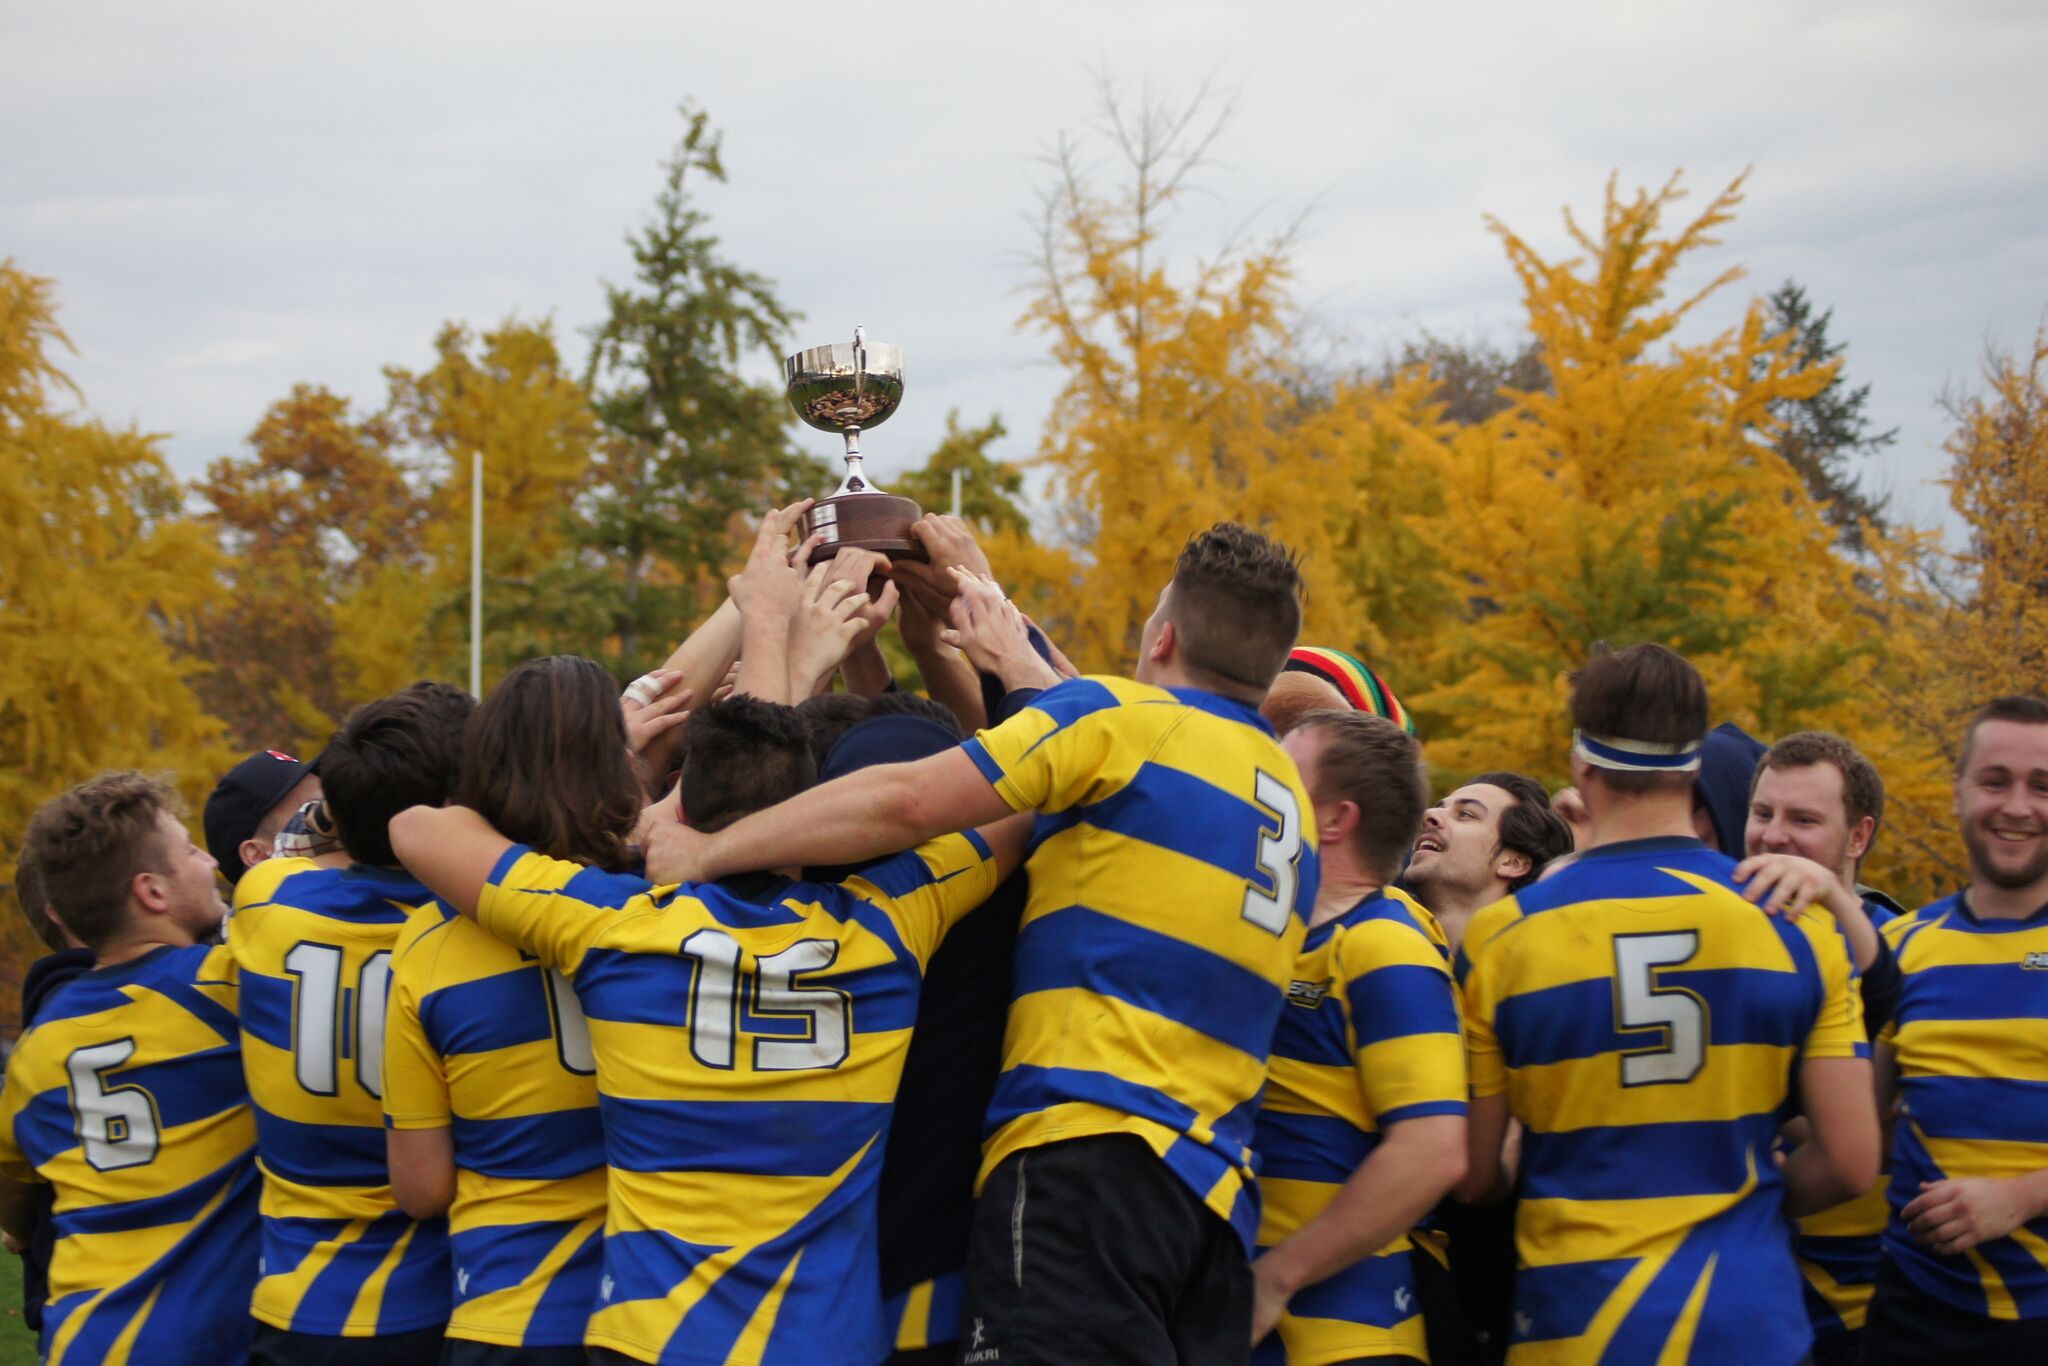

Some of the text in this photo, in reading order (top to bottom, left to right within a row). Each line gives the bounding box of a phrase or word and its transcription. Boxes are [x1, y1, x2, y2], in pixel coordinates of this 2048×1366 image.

[1241, 766, 1303, 940] 3
[679, 928, 853, 1072] 15
[1613, 928, 1710, 1088] 5
[66, 1035, 160, 1172] 6
